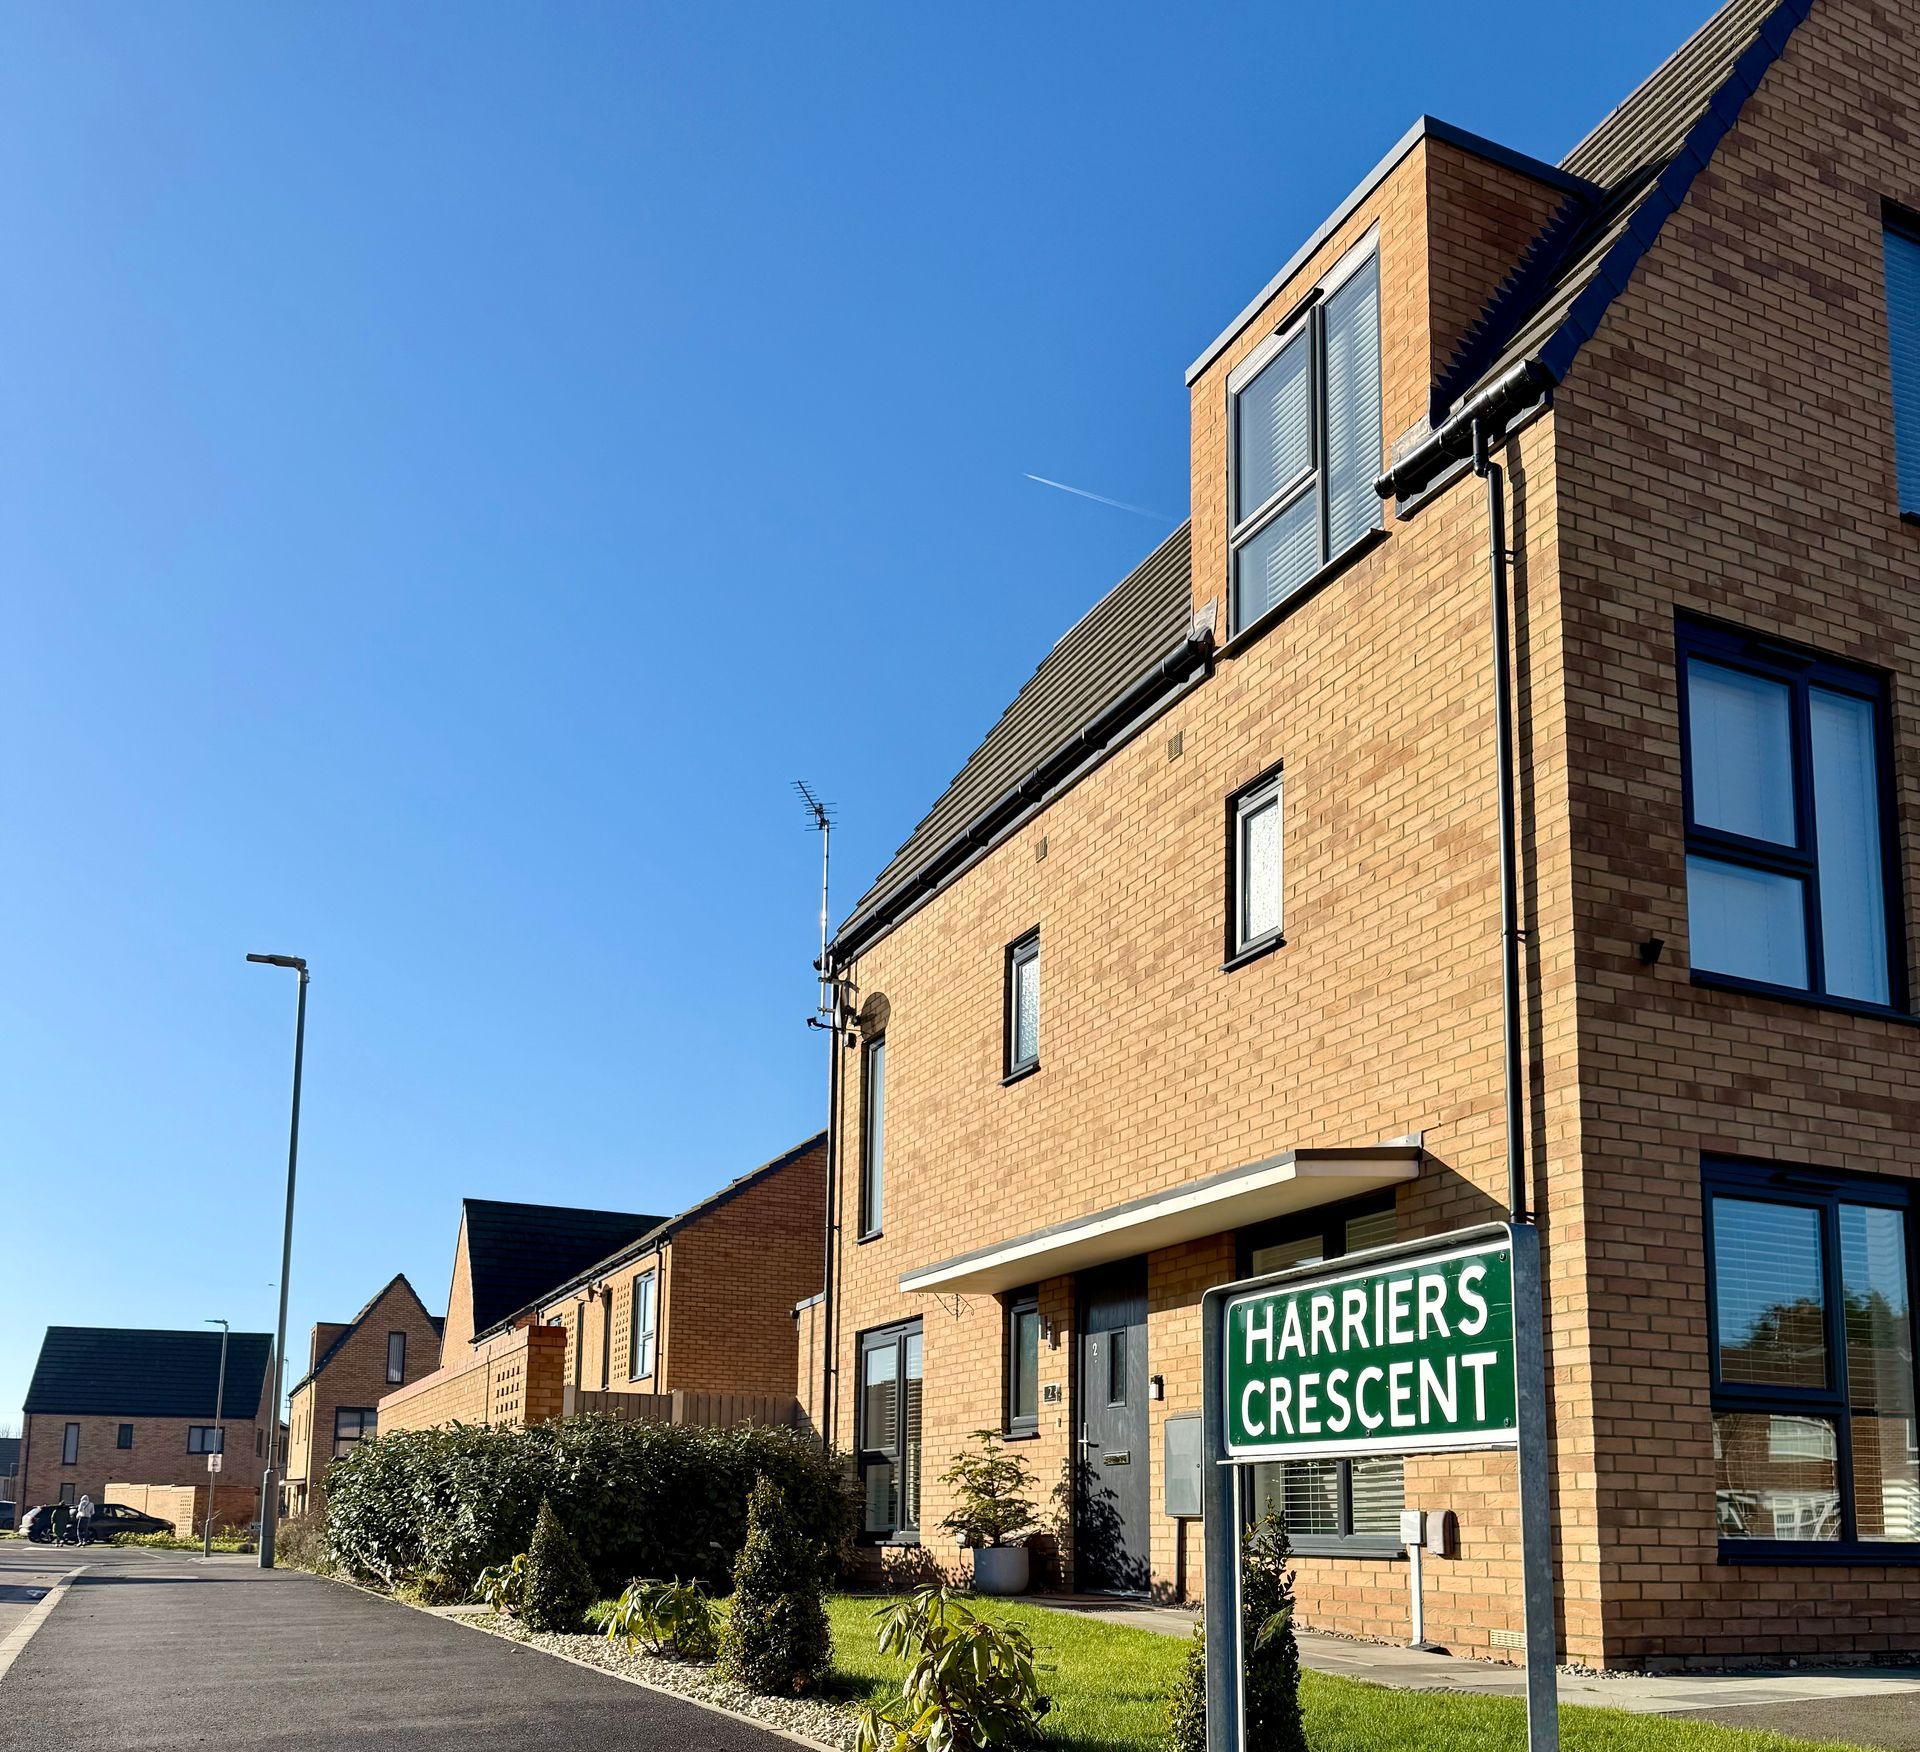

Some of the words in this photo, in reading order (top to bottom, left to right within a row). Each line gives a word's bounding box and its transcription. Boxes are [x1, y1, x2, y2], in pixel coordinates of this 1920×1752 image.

[1092, 1342, 1098, 1356] 2
[1246, 1265, 1488, 1364] HARRIERS
[1241, 1351, 1498, 1437] CRESCENT
